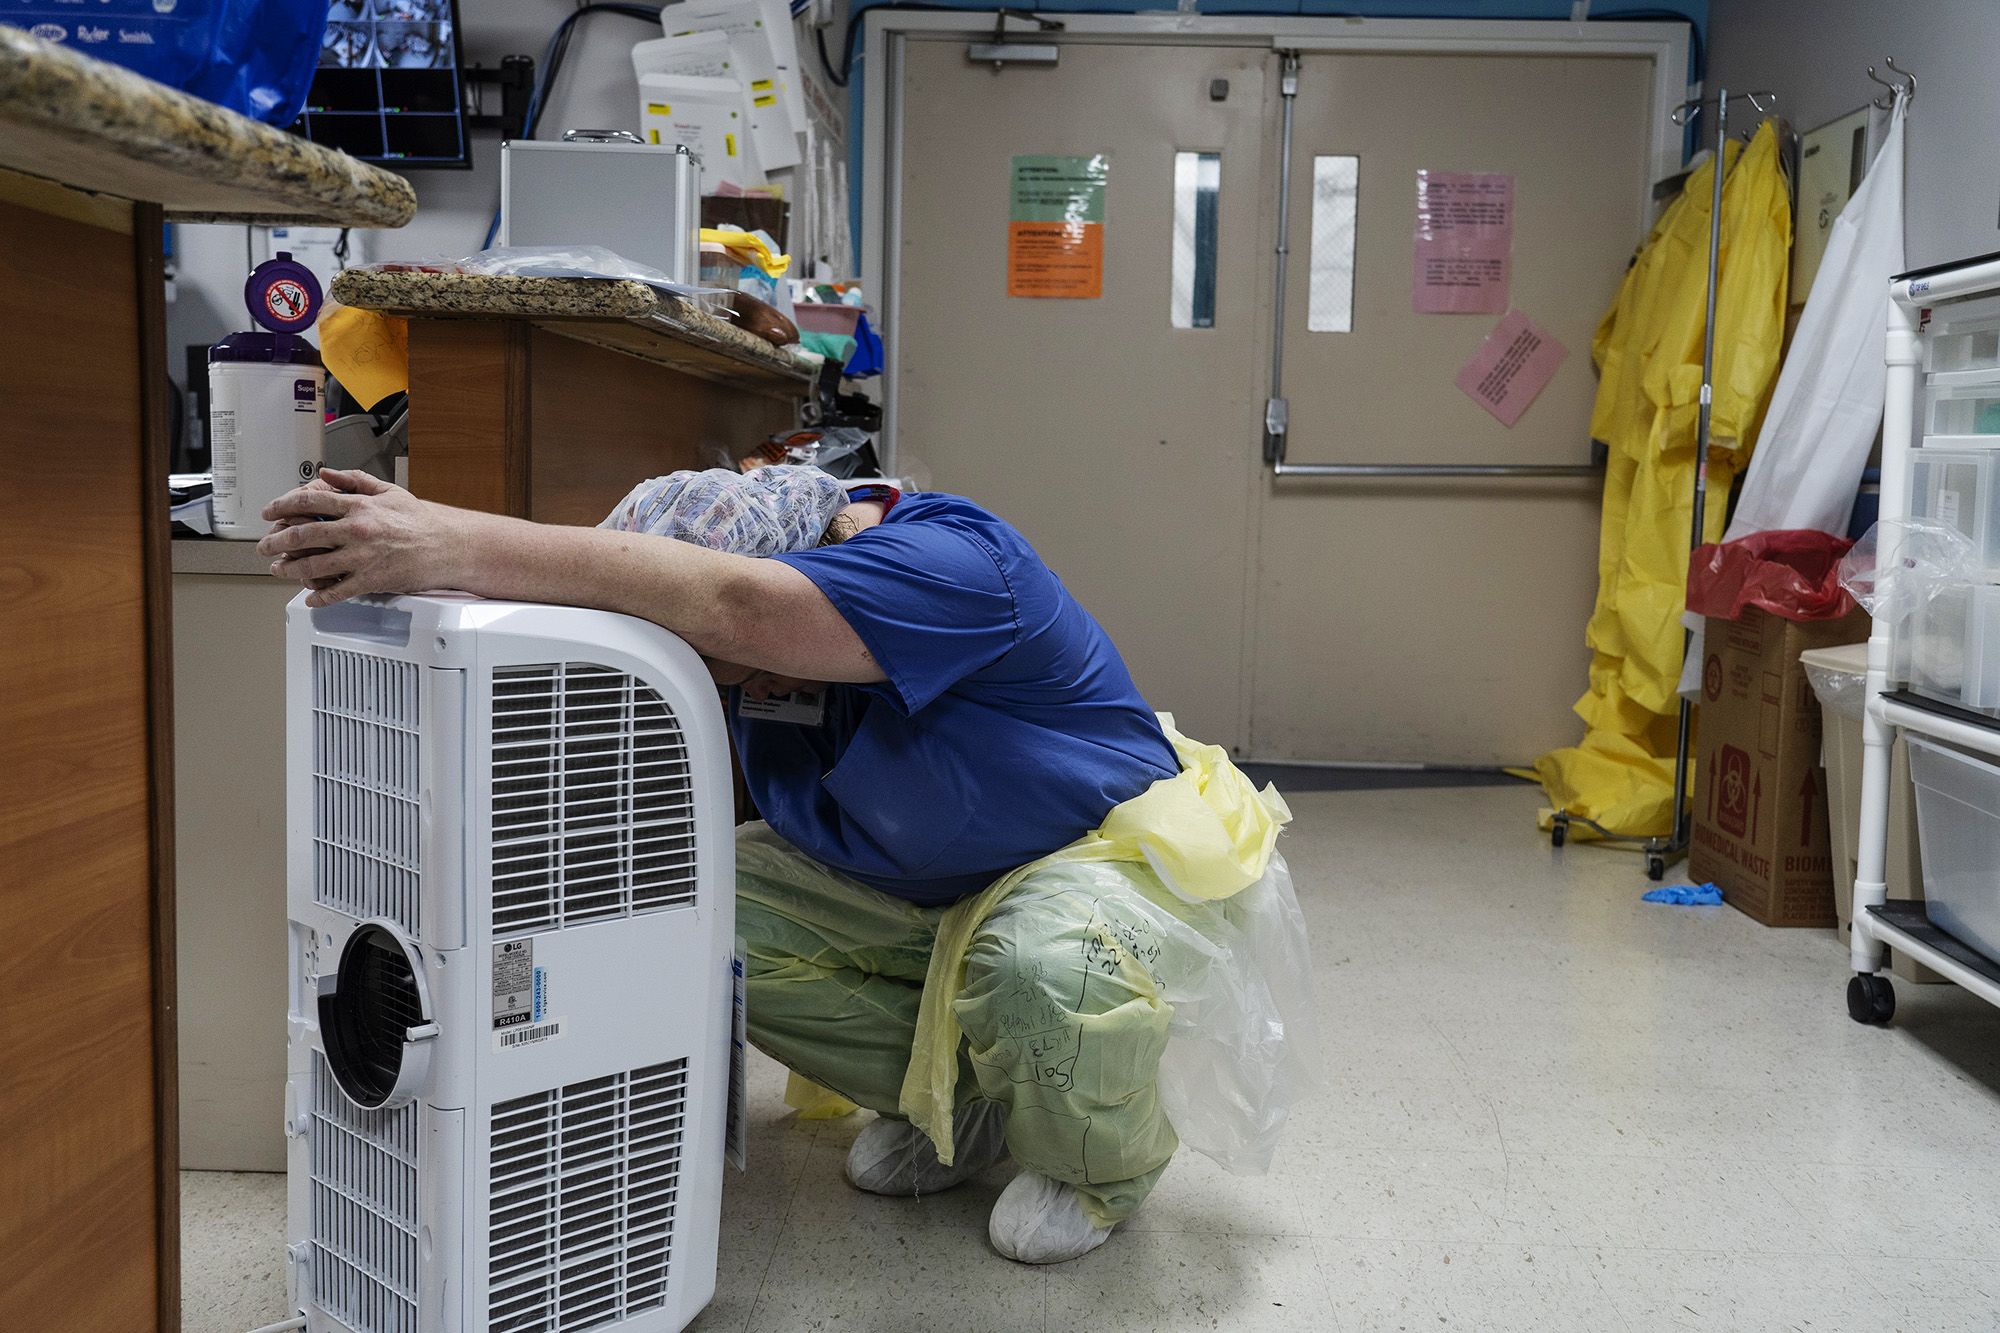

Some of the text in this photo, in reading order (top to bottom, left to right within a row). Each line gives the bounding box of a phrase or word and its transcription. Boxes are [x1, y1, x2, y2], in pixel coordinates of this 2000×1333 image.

[297, 384, 315, 393] Super
[1694, 822, 1739, 863] BIOMEDICAL
[1741, 849, 1771, 881] WASTE
[512, 942, 522, 951] LG
[499, 1015, 527, 1026] R410A
